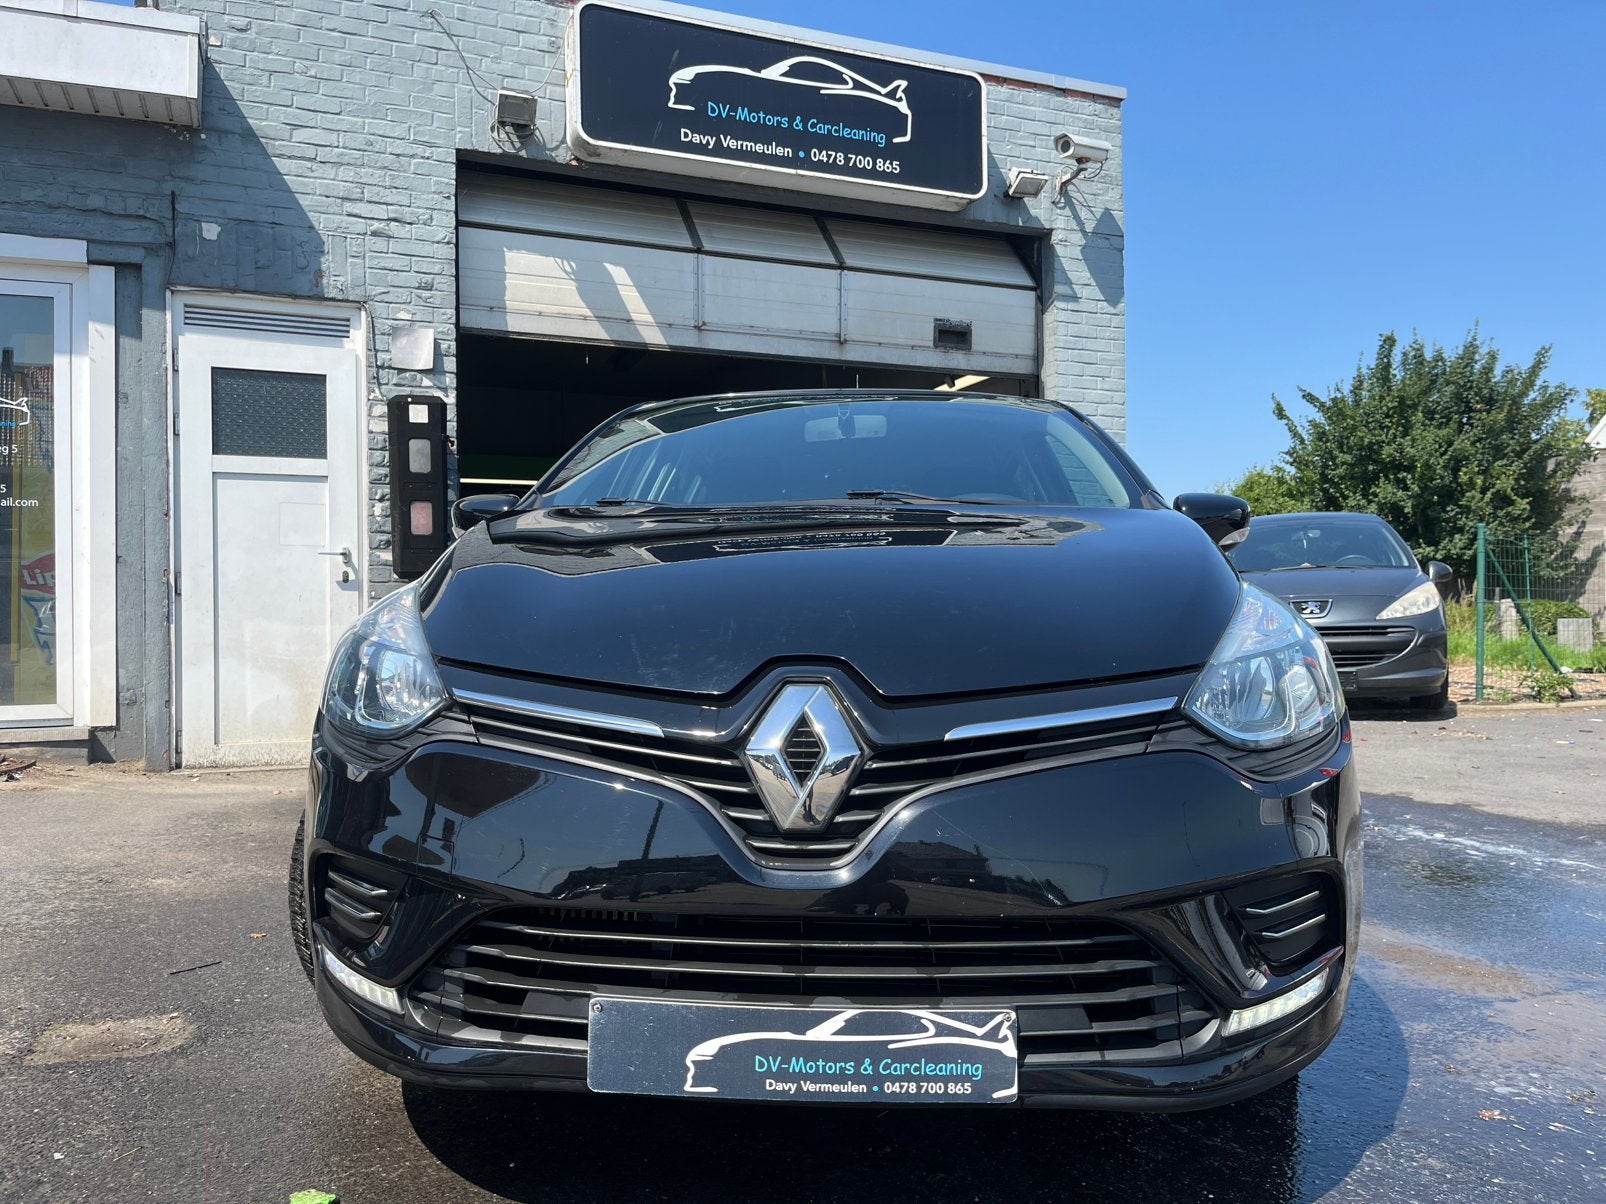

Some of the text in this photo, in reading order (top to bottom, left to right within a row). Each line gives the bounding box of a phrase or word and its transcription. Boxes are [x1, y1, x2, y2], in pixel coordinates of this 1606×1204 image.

[707, 101, 886, 147] DV-Motors & Carcleaning
[680, 128, 900, 173] Davy Vermeulen 0478 700 865
[11, 444, 18, 453] 5
[755, 1055, 983, 1081] DV-Motors & Carcleaning
[765, 1079, 972, 1095] Davy Vermeulen 0478 700 865
